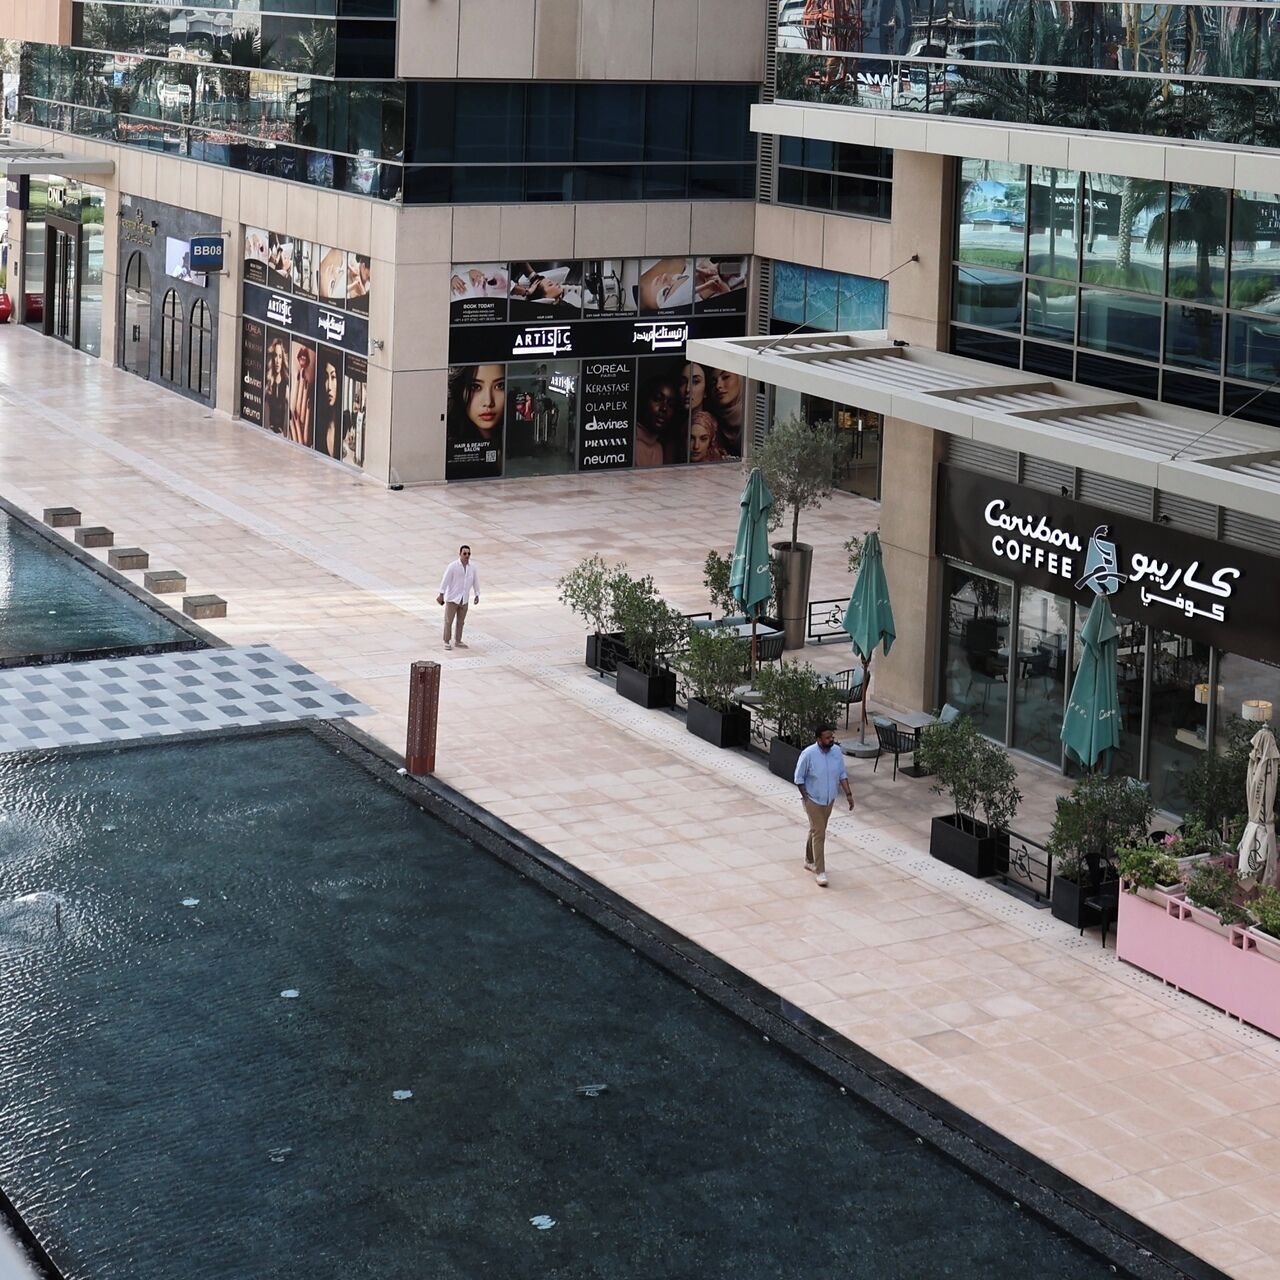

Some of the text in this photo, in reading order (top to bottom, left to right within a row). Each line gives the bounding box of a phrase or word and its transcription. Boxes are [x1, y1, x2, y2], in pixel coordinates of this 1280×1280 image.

[193, 245, 222, 256] BB08
[585, 401, 628, 412] OLAPLEX
[585, 415, 629, 431] davines
[584, 438, 628, 448] PRAVANA
[983, 499, 1082, 553] Caribou
[991, 535, 1073, 580] COFFEE
[1128, 553, 1241, 599] كاريبو
[1140, 586, 1225, 623] كوفي
